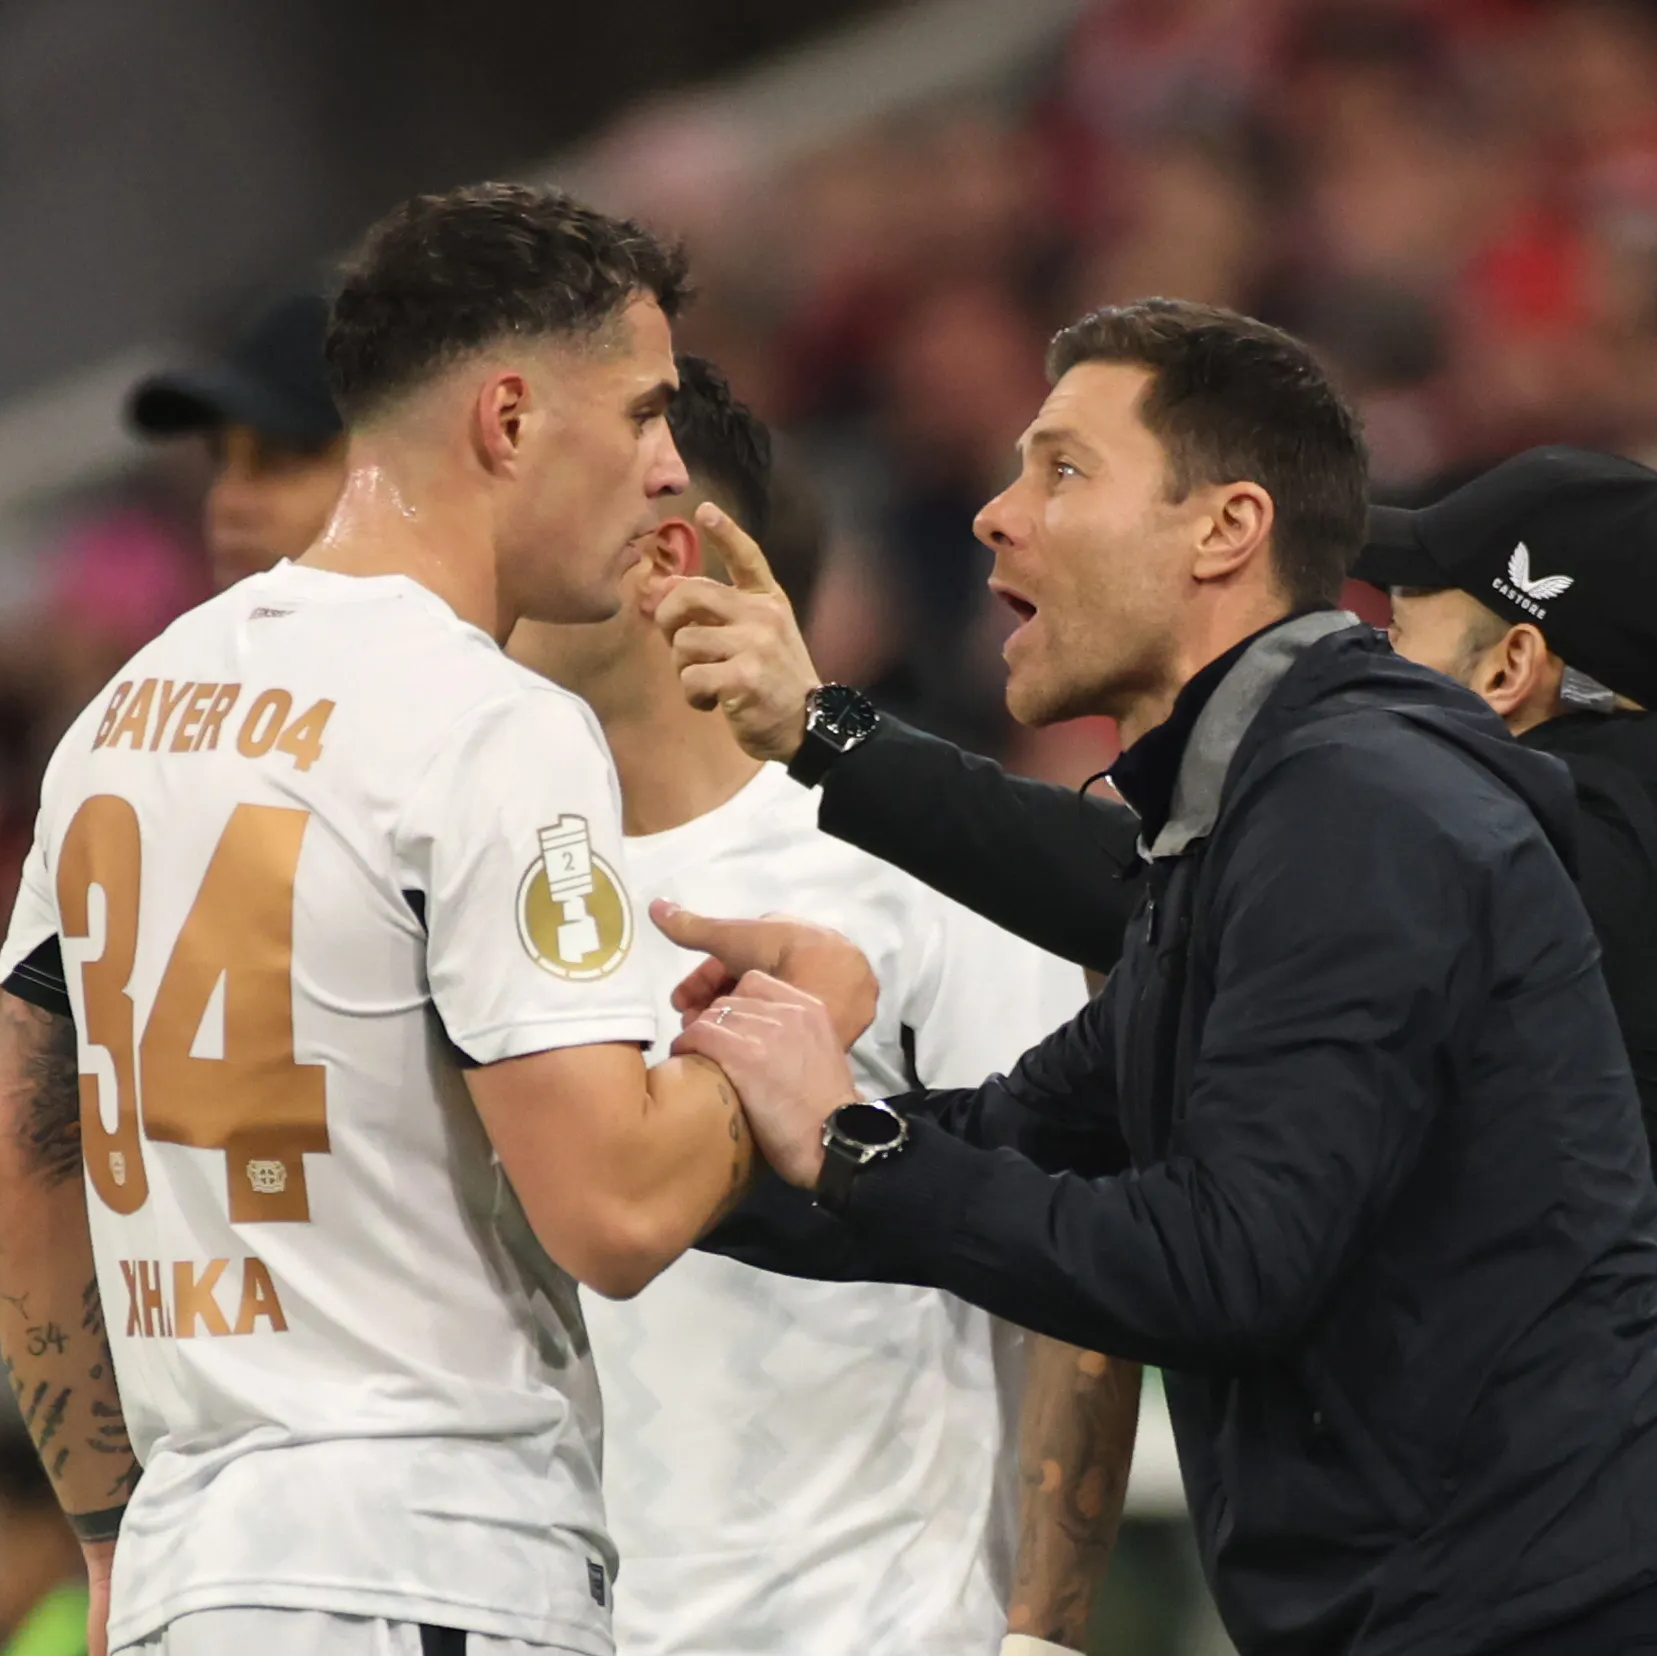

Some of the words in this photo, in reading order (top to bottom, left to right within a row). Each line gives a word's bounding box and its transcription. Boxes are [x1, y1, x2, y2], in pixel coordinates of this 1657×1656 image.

[1492, 577, 1547, 620] CASTORE
[91, 678, 242, 754] BAYER
[236, 688, 337, 773] 04
[561, 851, 576, 872] 2
[56, 794, 332, 1224] 34
[119, 1256, 289, 1339] XHKA
[26, 1320, 68, 1356] 34
